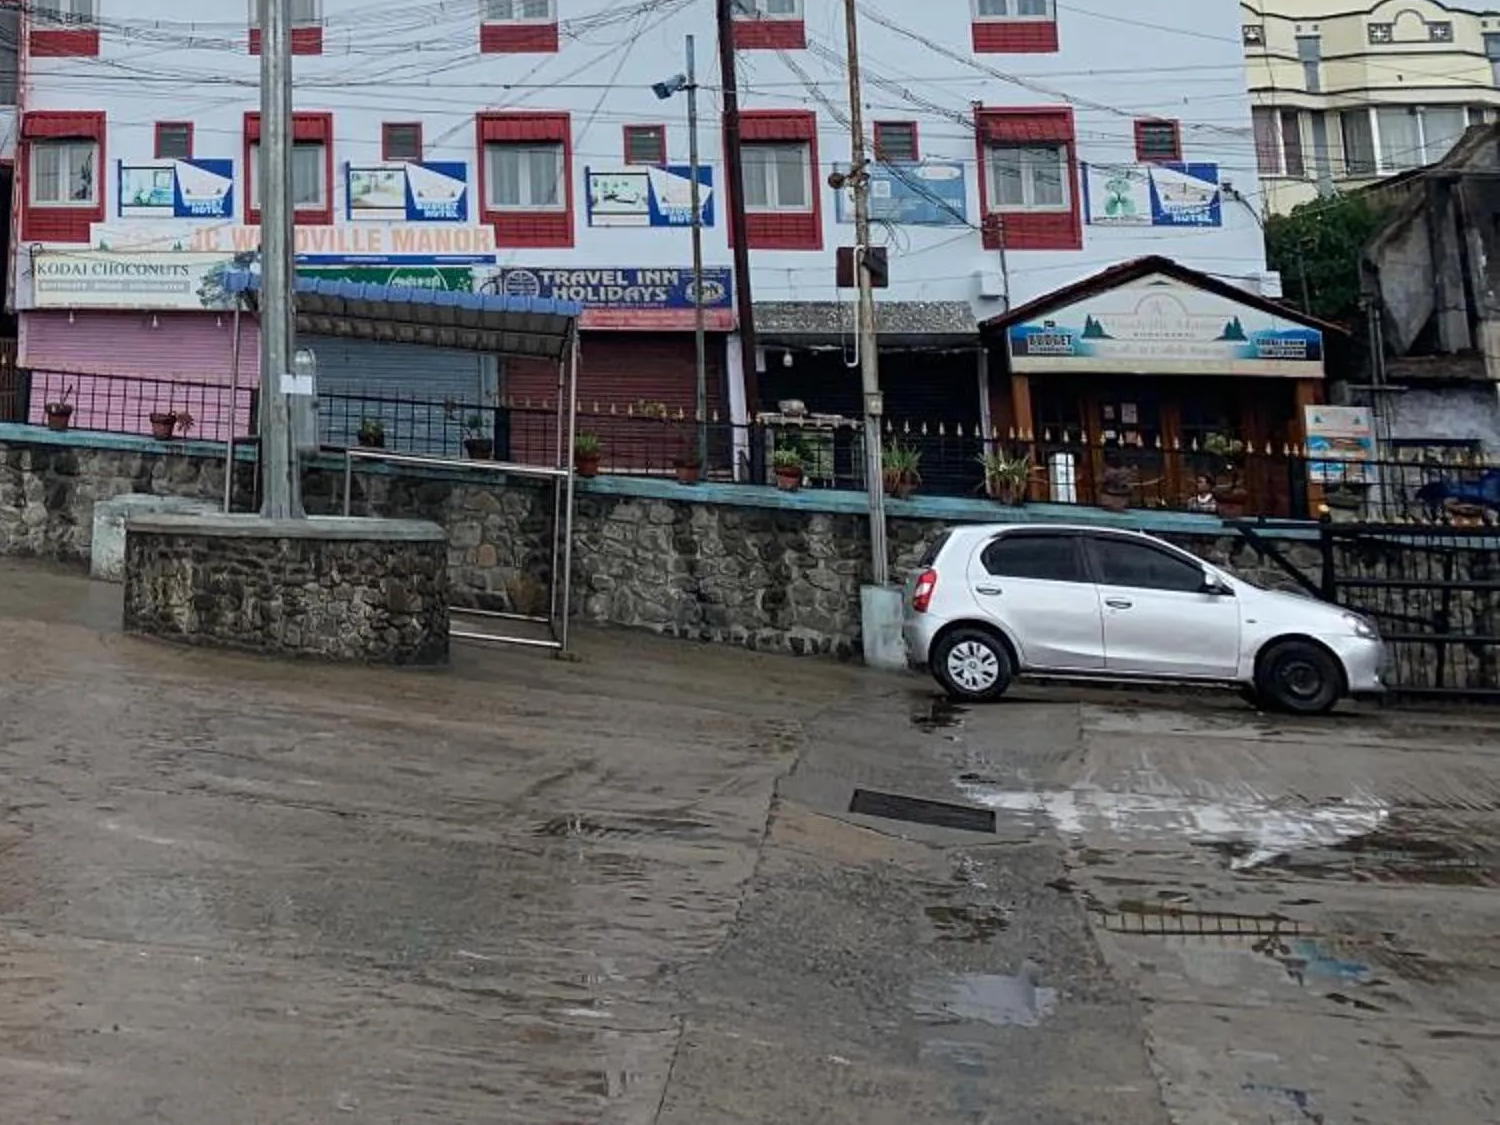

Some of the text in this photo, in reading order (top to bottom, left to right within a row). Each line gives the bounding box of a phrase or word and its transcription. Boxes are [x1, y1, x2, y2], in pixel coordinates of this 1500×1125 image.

[232, 227, 382, 252] WDVILLE
[391, 227, 489, 252] MANOR
[37, 262, 189, 276] KODAI CHOCONUTS
[537, 270, 628, 285] TRAVEL
[637, 270, 679, 285] INN
[552, 286, 668, 302] HOLIDAYS
[1028, 335, 1071, 346] BUDGET
